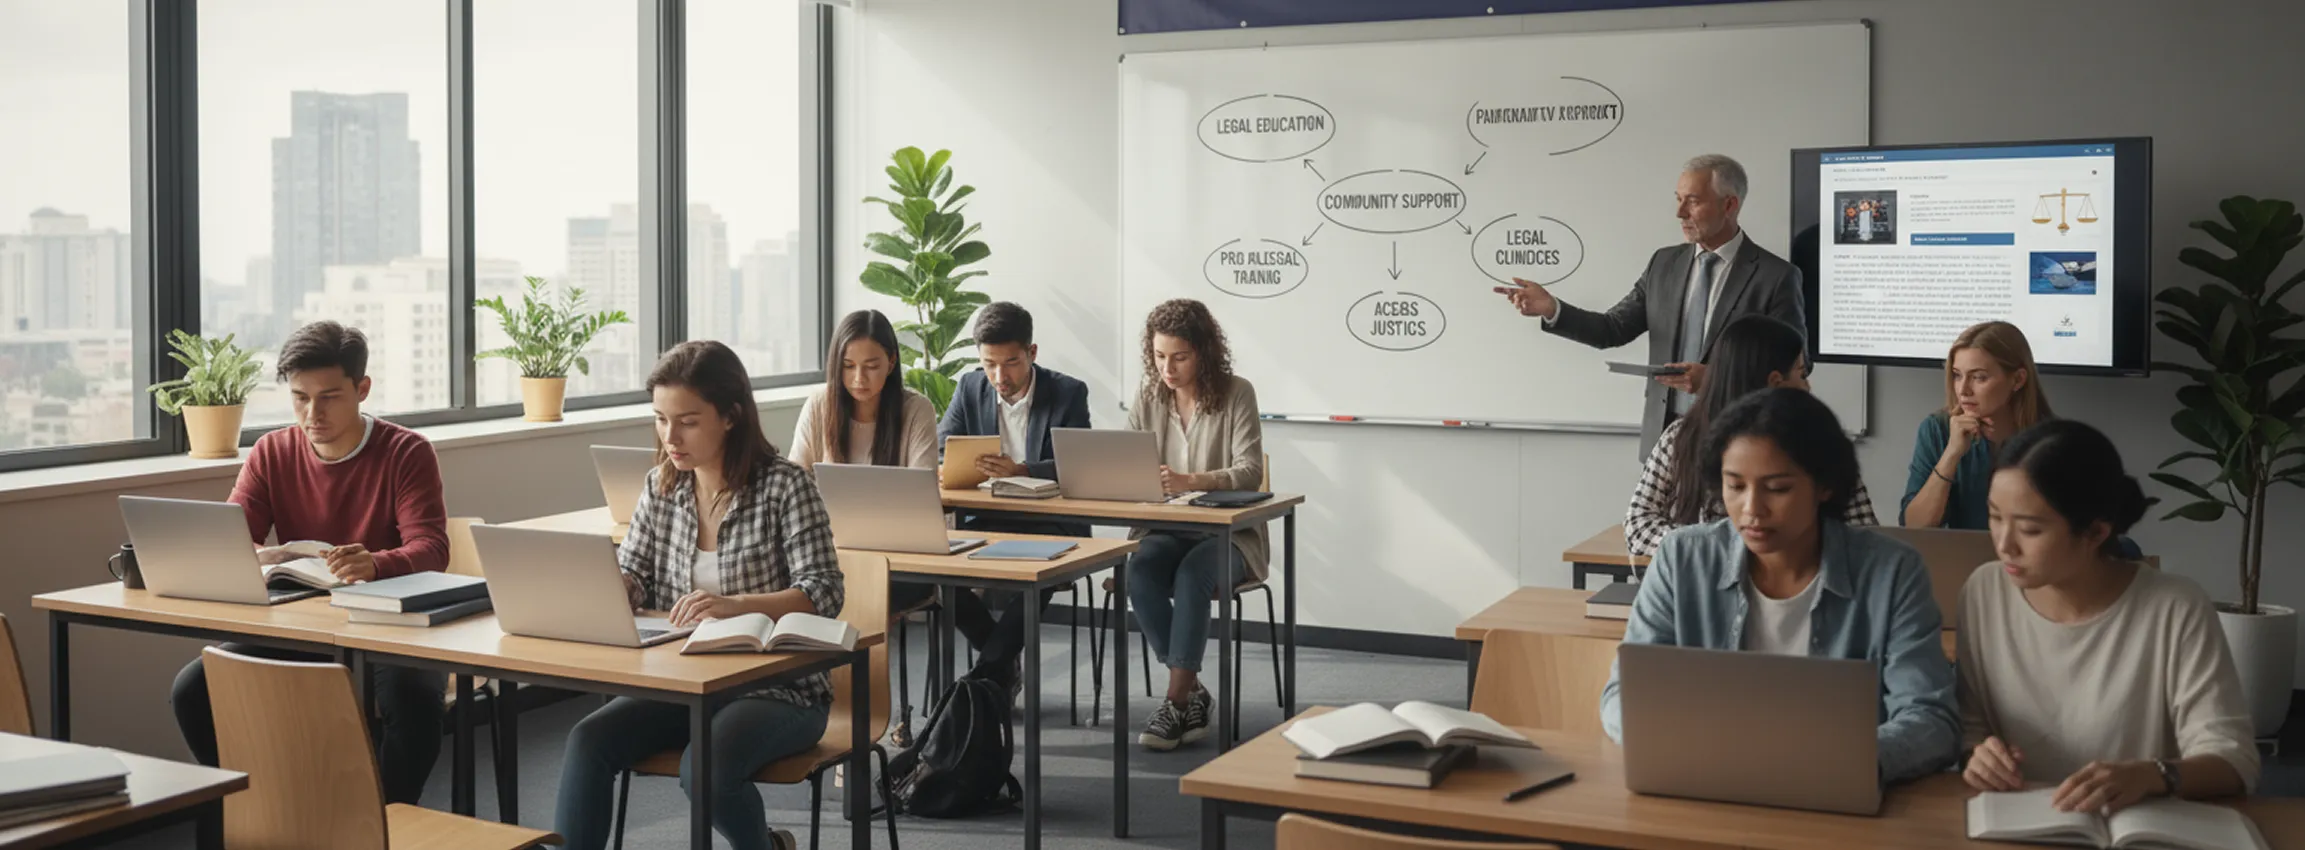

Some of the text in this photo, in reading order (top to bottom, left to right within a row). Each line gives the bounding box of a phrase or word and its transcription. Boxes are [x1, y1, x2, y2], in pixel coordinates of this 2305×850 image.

[1217, 118, 1252, 134] LEGAL
[1402, 192, 1460, 209] SUPPORT
[1506, 229, 1547, 245] LEGAL
[1220, 251, 1245, 266] PRO
[1370, 320, 1427, 336] JUSTICS
